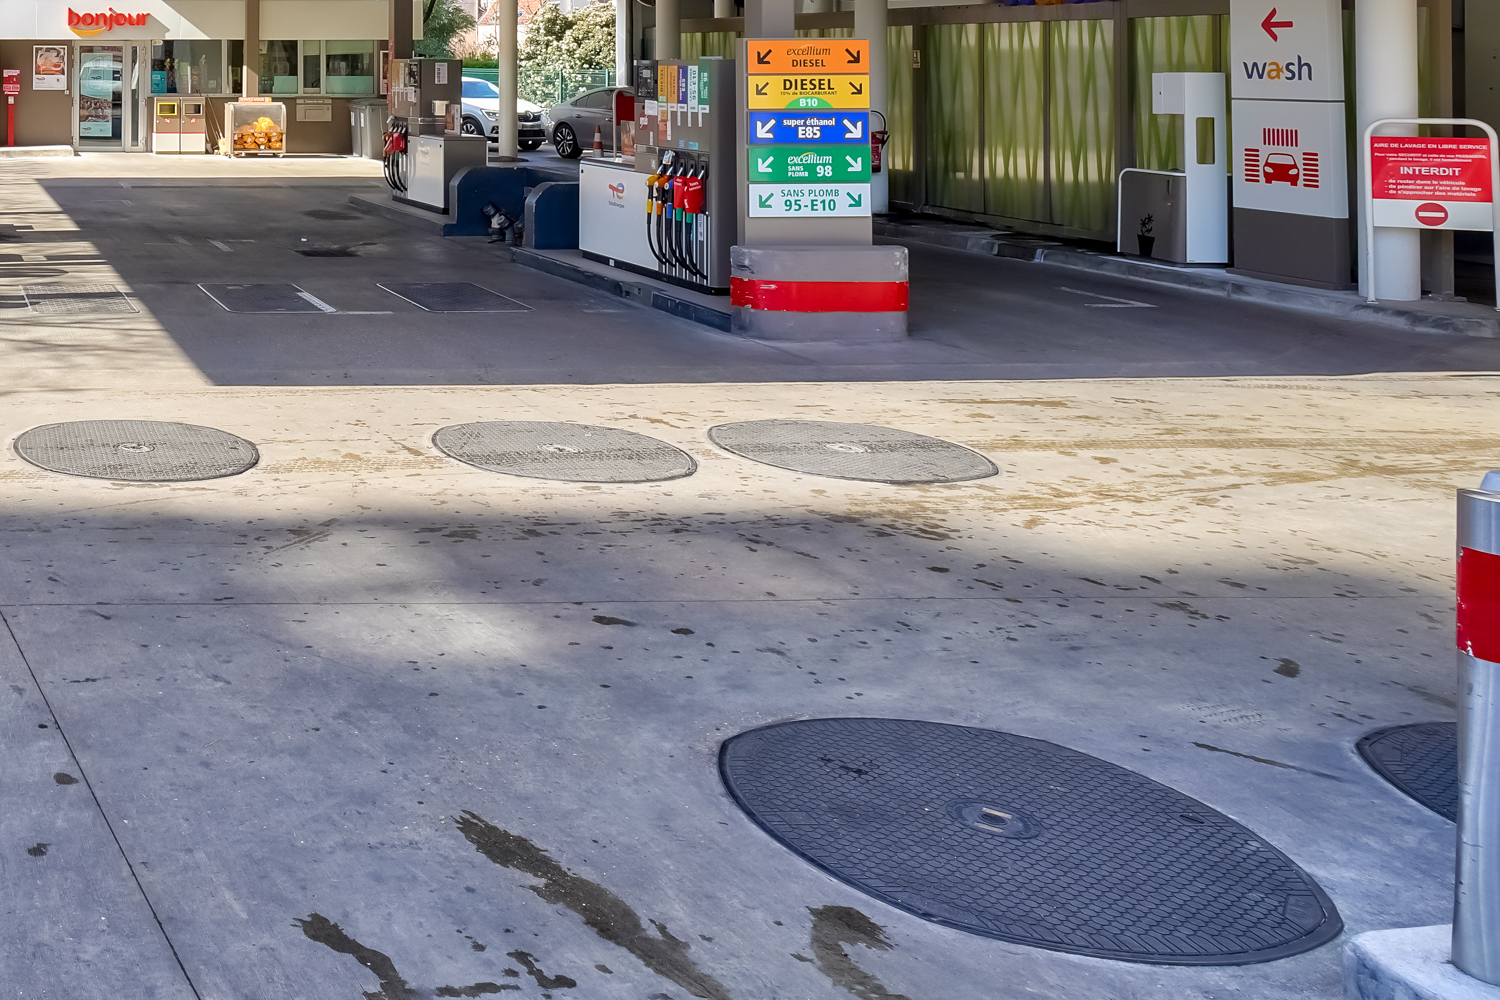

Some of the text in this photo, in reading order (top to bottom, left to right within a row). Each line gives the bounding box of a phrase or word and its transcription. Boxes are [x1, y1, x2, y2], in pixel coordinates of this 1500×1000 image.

[67, 7, 150, 31] bonjour
[787, 45, 831, 56] excellium
[791, 59, 826, 67] DIESEL
[1242, 54, 1313, 81] wash
[783, 78, 835, 90] DIESEL
[799, 98, 818, 107] B10
[782, 117, 836, 127] super éthanol
[798, 127, 821, 139] E85
[787, 152, 832, 164] excellium
[816, 165, 833, 177] 98
[1400, 166, 1461, 176] INTERDIT
[780, 189, 840, 197] SANS PLOMB
[784, 199, 837, 212] 95-E10
